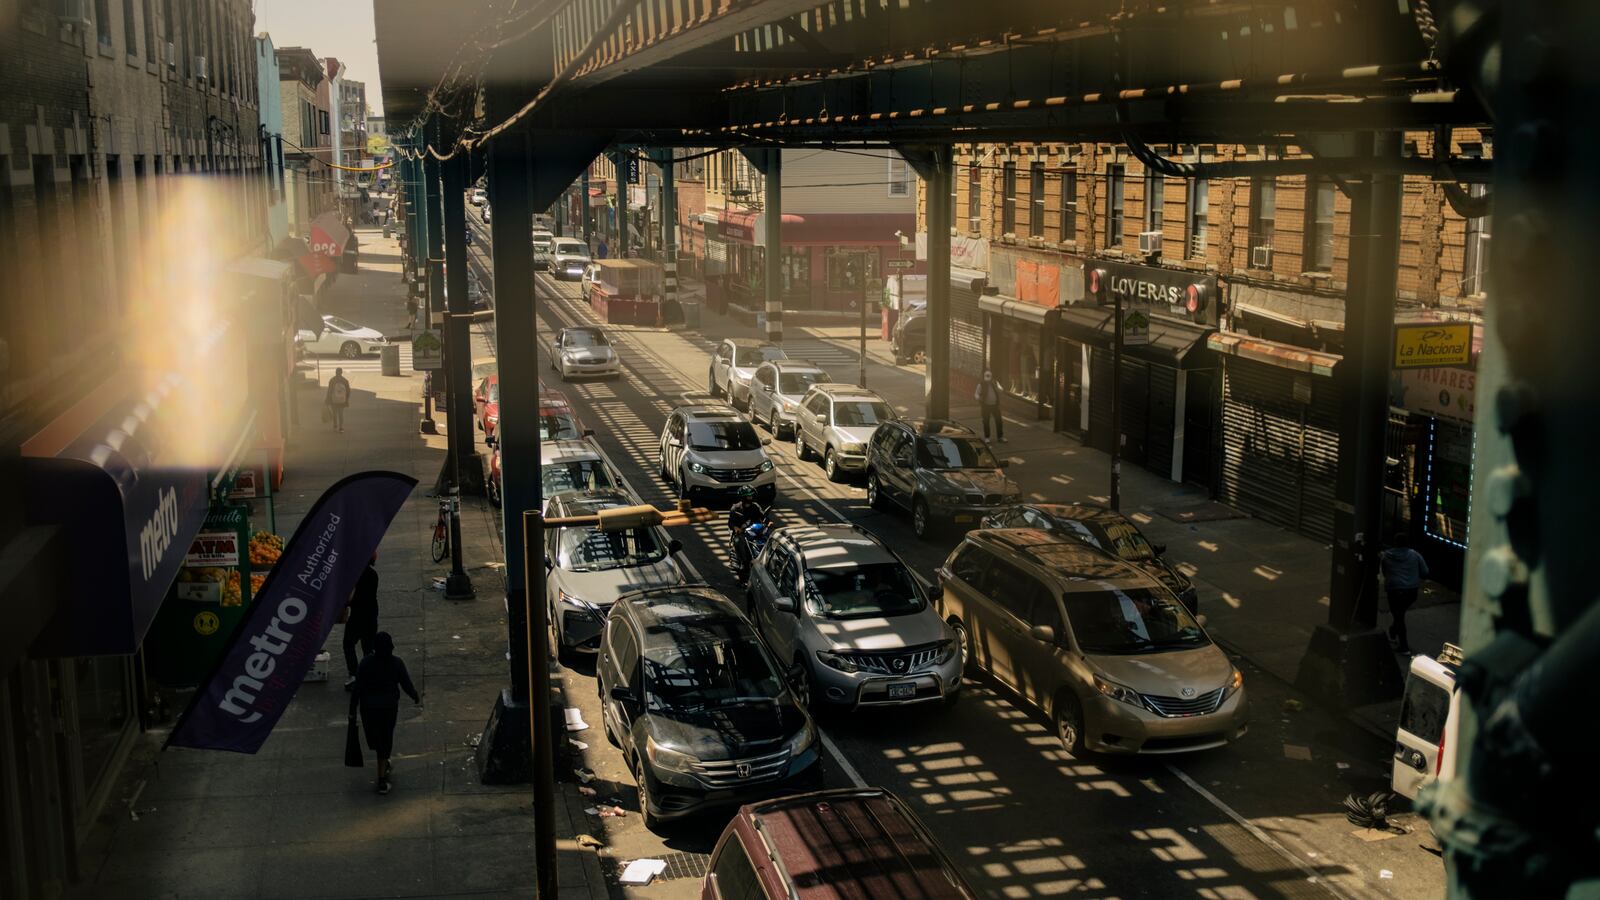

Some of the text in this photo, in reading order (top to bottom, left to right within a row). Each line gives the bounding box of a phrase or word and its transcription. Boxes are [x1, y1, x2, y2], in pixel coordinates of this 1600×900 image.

[1111, 275, 1178, 304] LOVERAS
[1399, 341, 1466, 356] La Nacional
[1417, 367, 1475, 392] TAVARES
[140, 485, 178, 581] metro
[188, 541, 235, 554] ATM
[297, 512, 341, 584] Authorized
[310, 549, 340, 591] Dealer
[218, 596, 308, 724] metro
